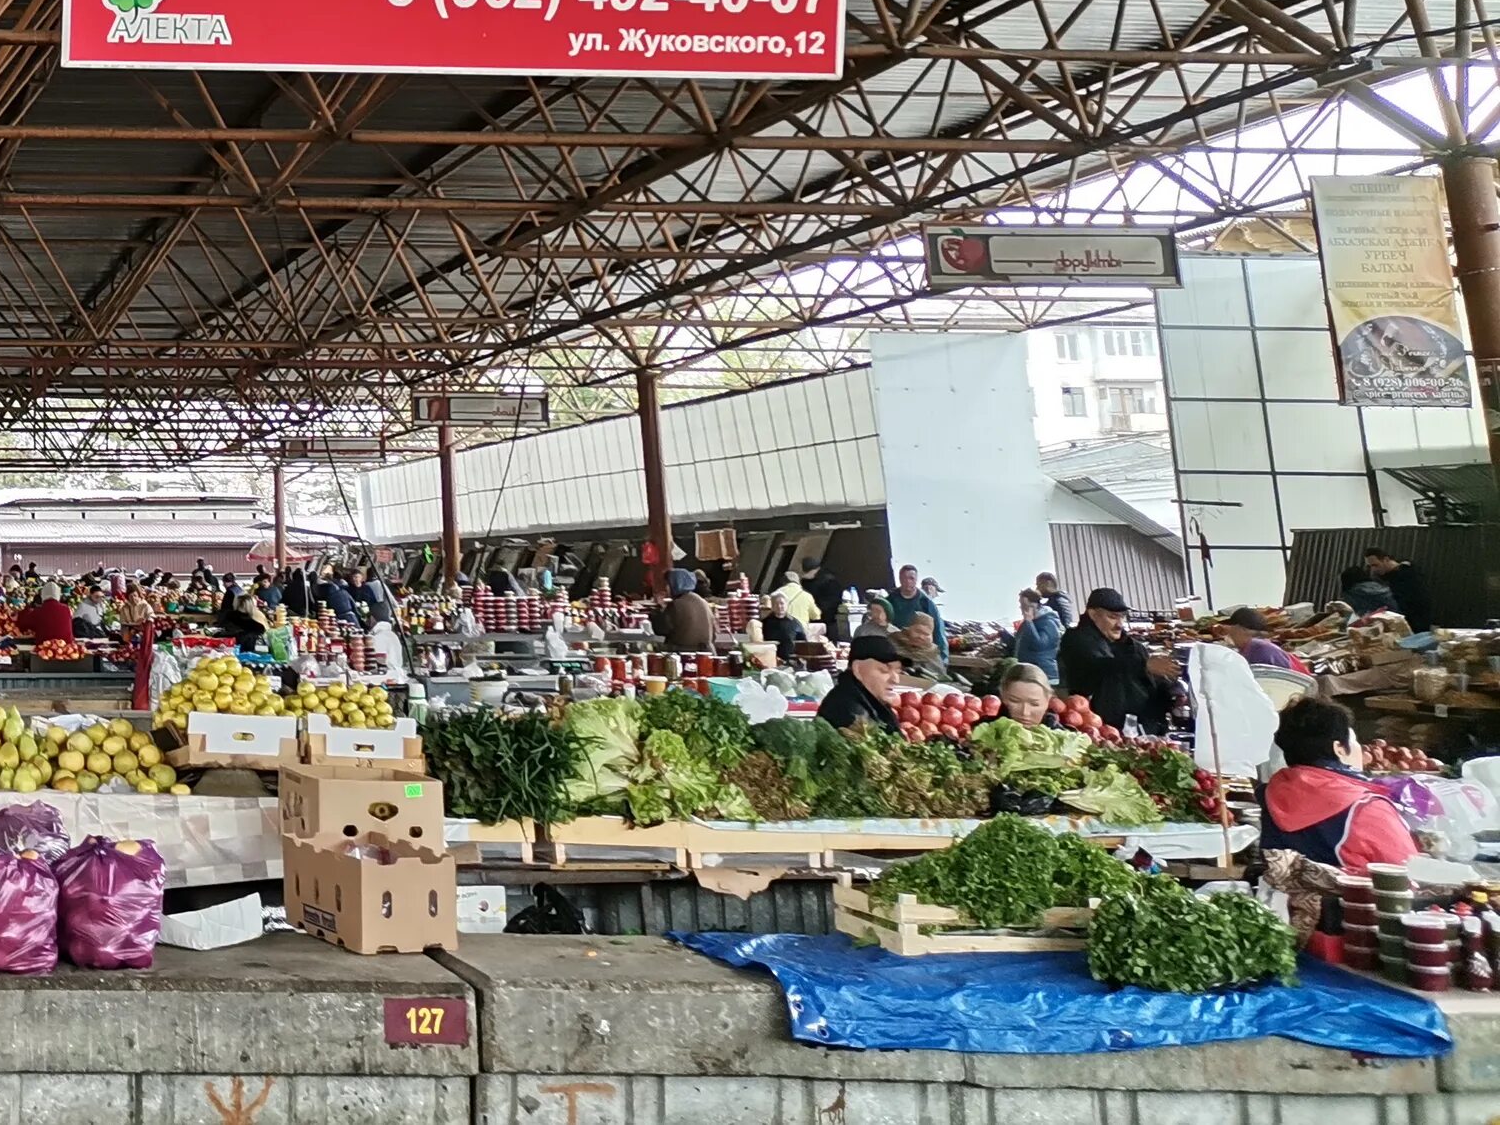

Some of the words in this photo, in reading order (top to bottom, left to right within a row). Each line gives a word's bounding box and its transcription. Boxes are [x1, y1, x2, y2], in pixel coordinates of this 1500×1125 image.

[111, 16, 228, 40] АЛЕКТА
[568, 33, 610, 57] ул.
[618, 28, 826, 58] Жуковского,12
[1364, 251, 1407, 261] УРБЕЧ
[1361, 264, 1414, 274] БАЛХАМ
[405, 1007, 445, 1035] 127
